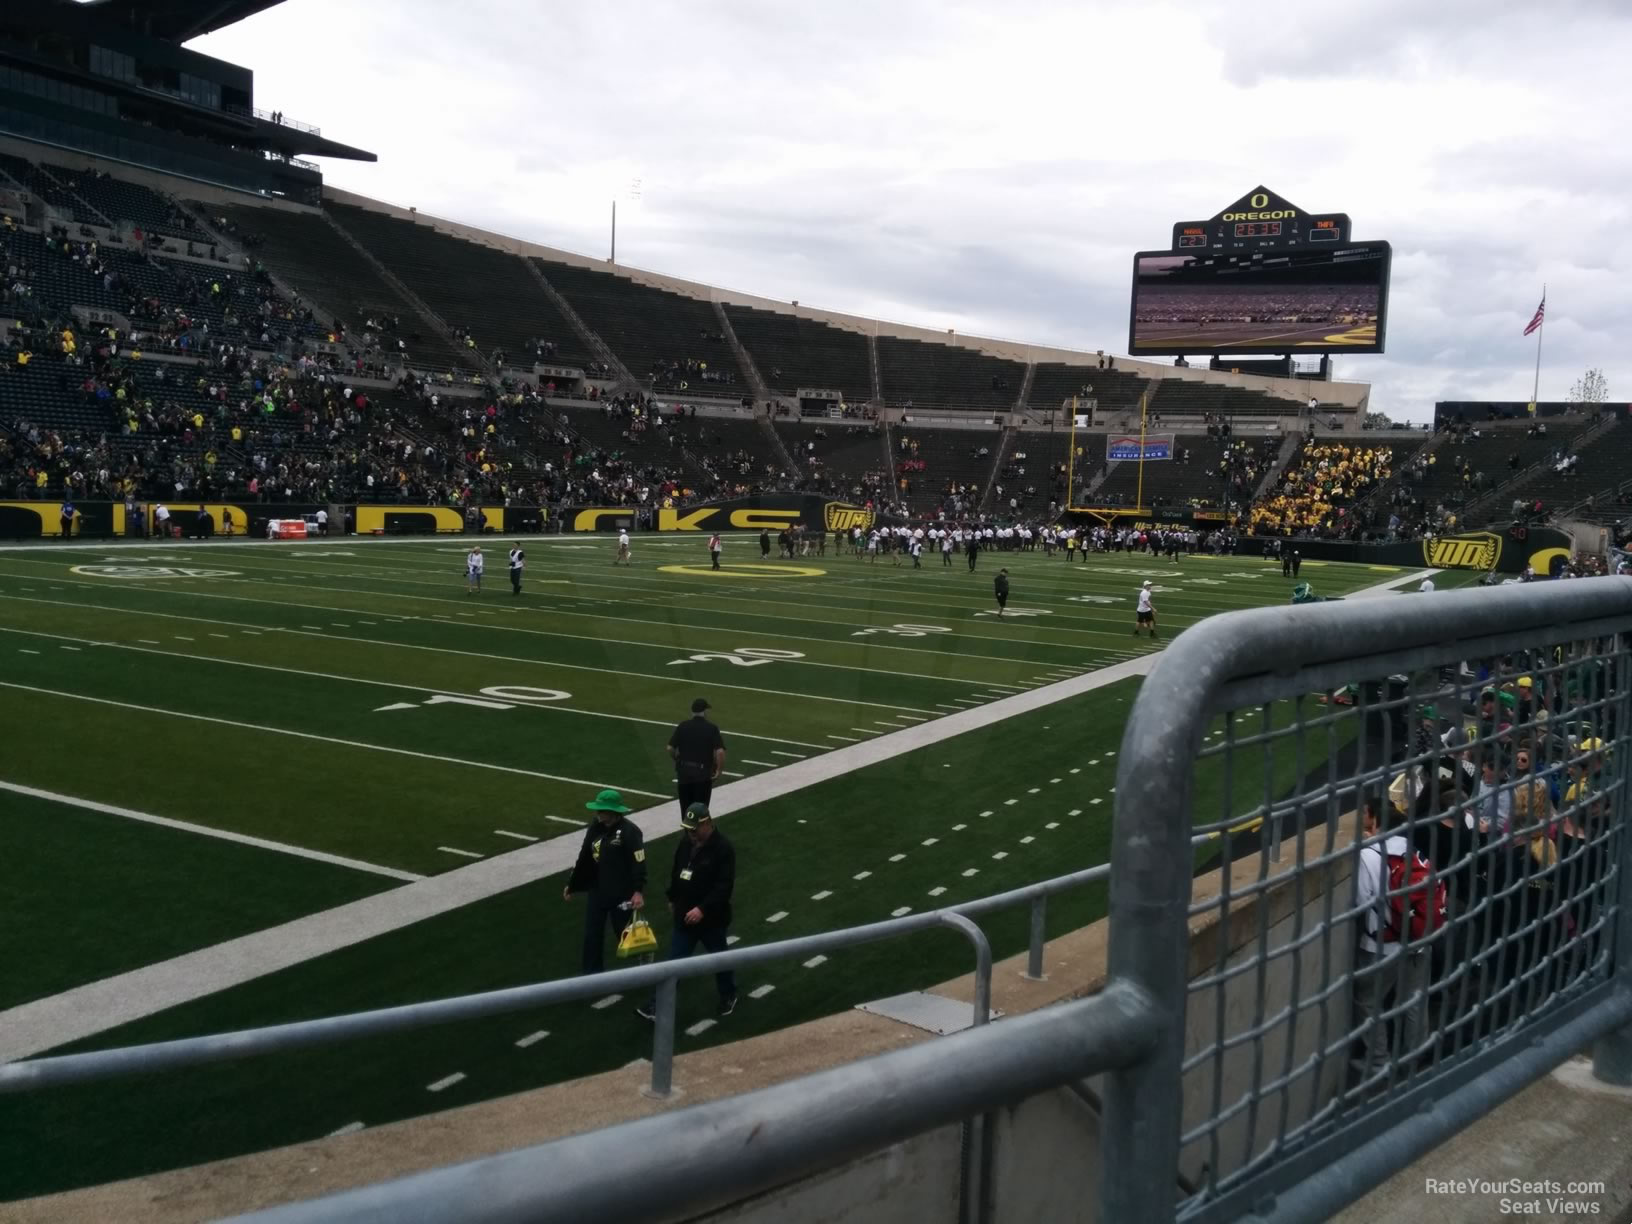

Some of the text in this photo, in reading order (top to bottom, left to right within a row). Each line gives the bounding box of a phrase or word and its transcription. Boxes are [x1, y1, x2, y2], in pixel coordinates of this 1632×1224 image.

[1251, 193, 1269, 208] O
[1222, 209, 1296, 221] OREGON
[689, 647, 806, 667] 20
[421, 685, 573, 710] 10
